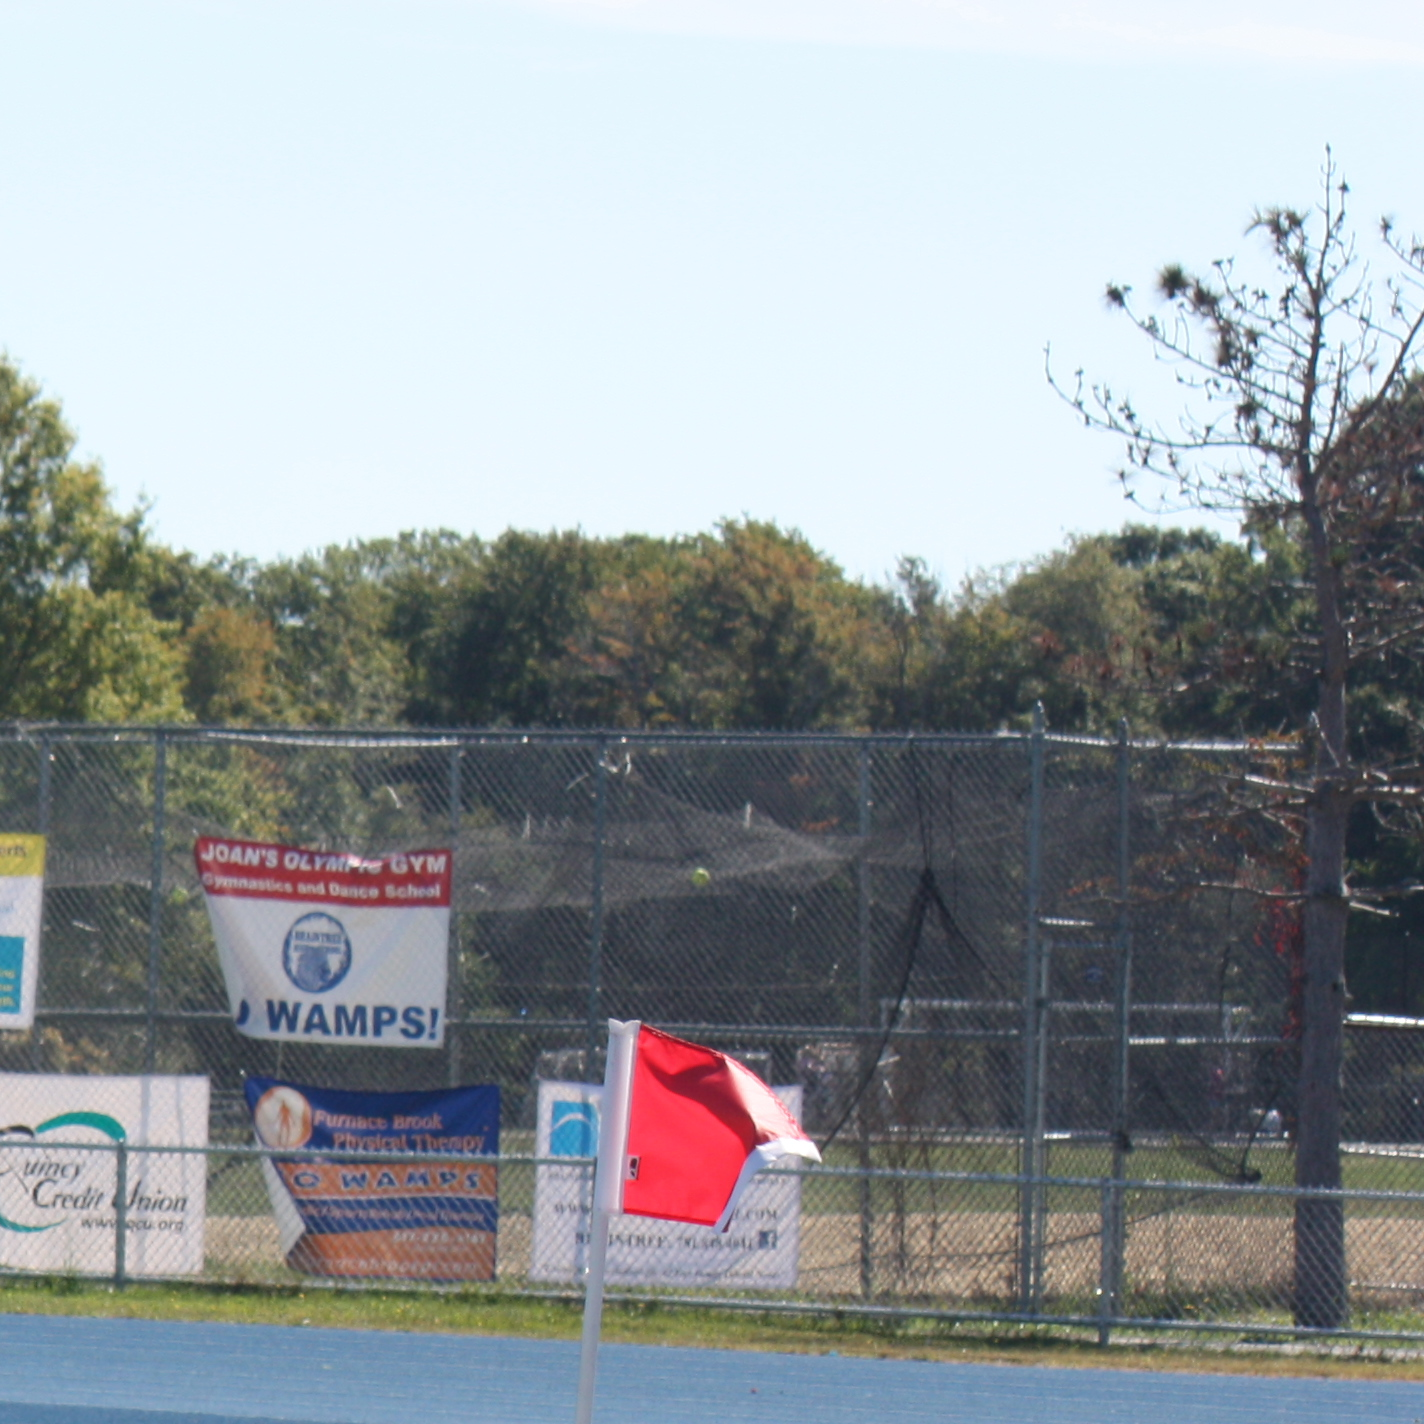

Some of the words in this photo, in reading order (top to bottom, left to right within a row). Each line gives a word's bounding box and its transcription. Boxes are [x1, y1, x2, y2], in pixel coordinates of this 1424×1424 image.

[202, 844, 278, 868] JOAN'S
[390, 855, 448, 876] GYM
[203, 873, 293, 893] Gymnastics
[298, 882, 325, 895] and
[329, 882, 379, 899] Dance
[385, 884, 442, 899] School
[266, 998, 439, 1041] WAMPS!
[313, 1109, 388, 1130] Furnace
[393, 1113, 443, 1130] Brook
[340, 1170, 481, 1189] WAMPS
[32, 1179, 104, 1212] Credit
